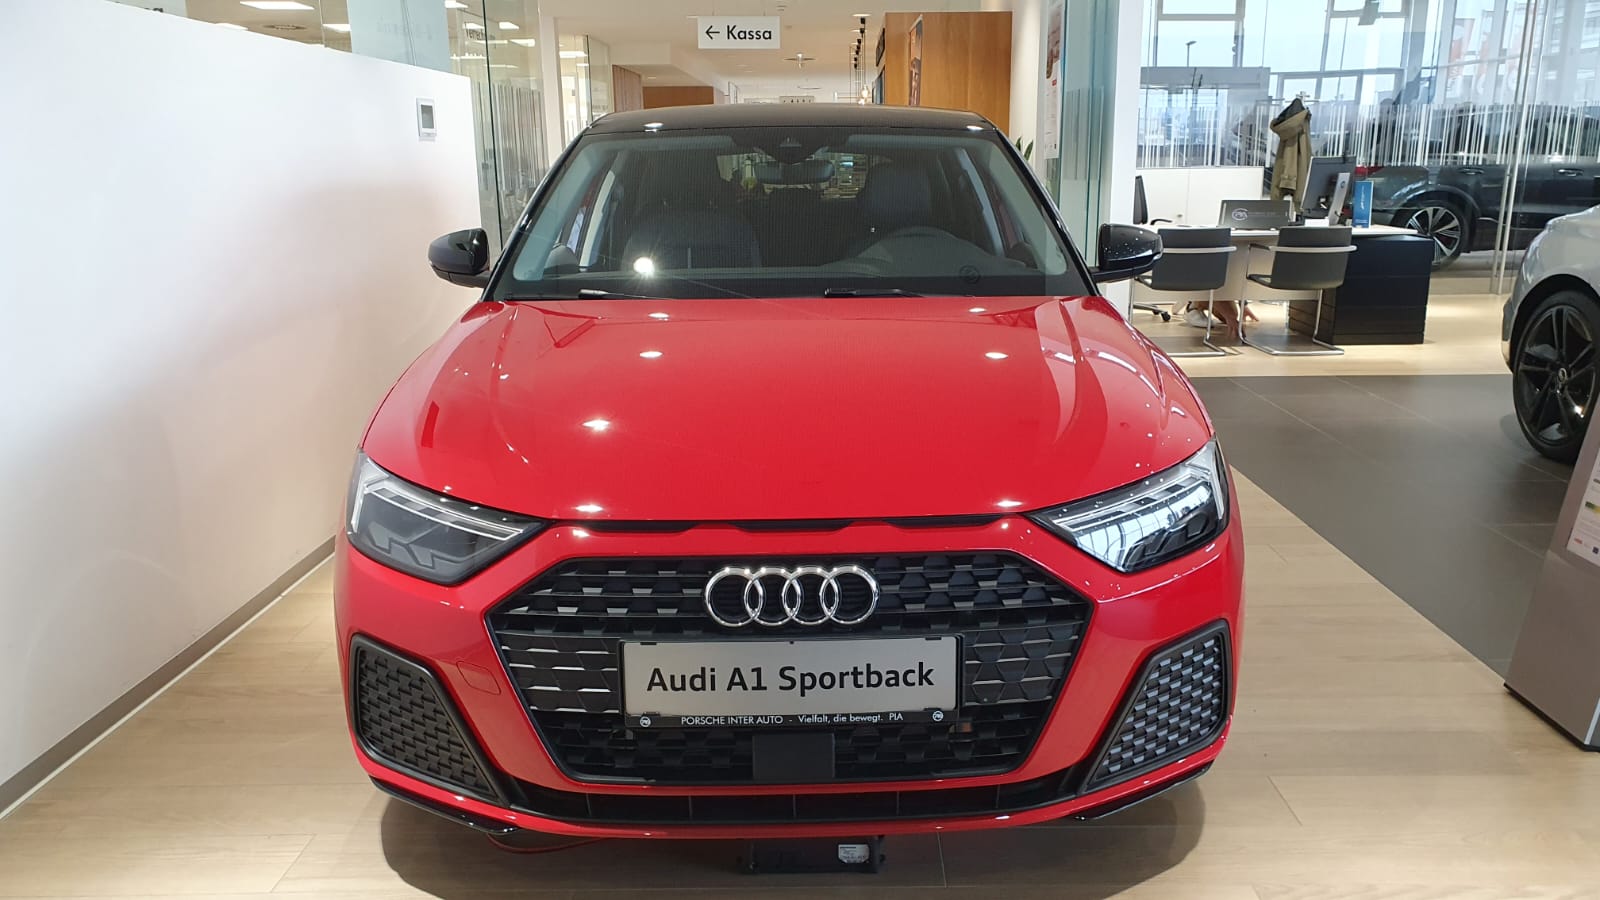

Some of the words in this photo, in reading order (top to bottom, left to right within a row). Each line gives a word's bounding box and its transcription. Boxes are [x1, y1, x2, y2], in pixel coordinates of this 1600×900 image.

[726, 24, 772, 40] Kassa
[646, 666, 716, 692] Audi
[726, 666, 768, 691] A1
[778, 661, 935, 697] Sportback
[681, 716, 725, 725] PORSCHE
[727, 716, 754, 725] INTER
[755, 715, 784, 724] AUTO
[798, 714, 831, 724] Vielfalt,
[833, 713, 847, 723] die
[849, 713, 884, 723] bewegt.
[889, 712, 904, 721] PIA
